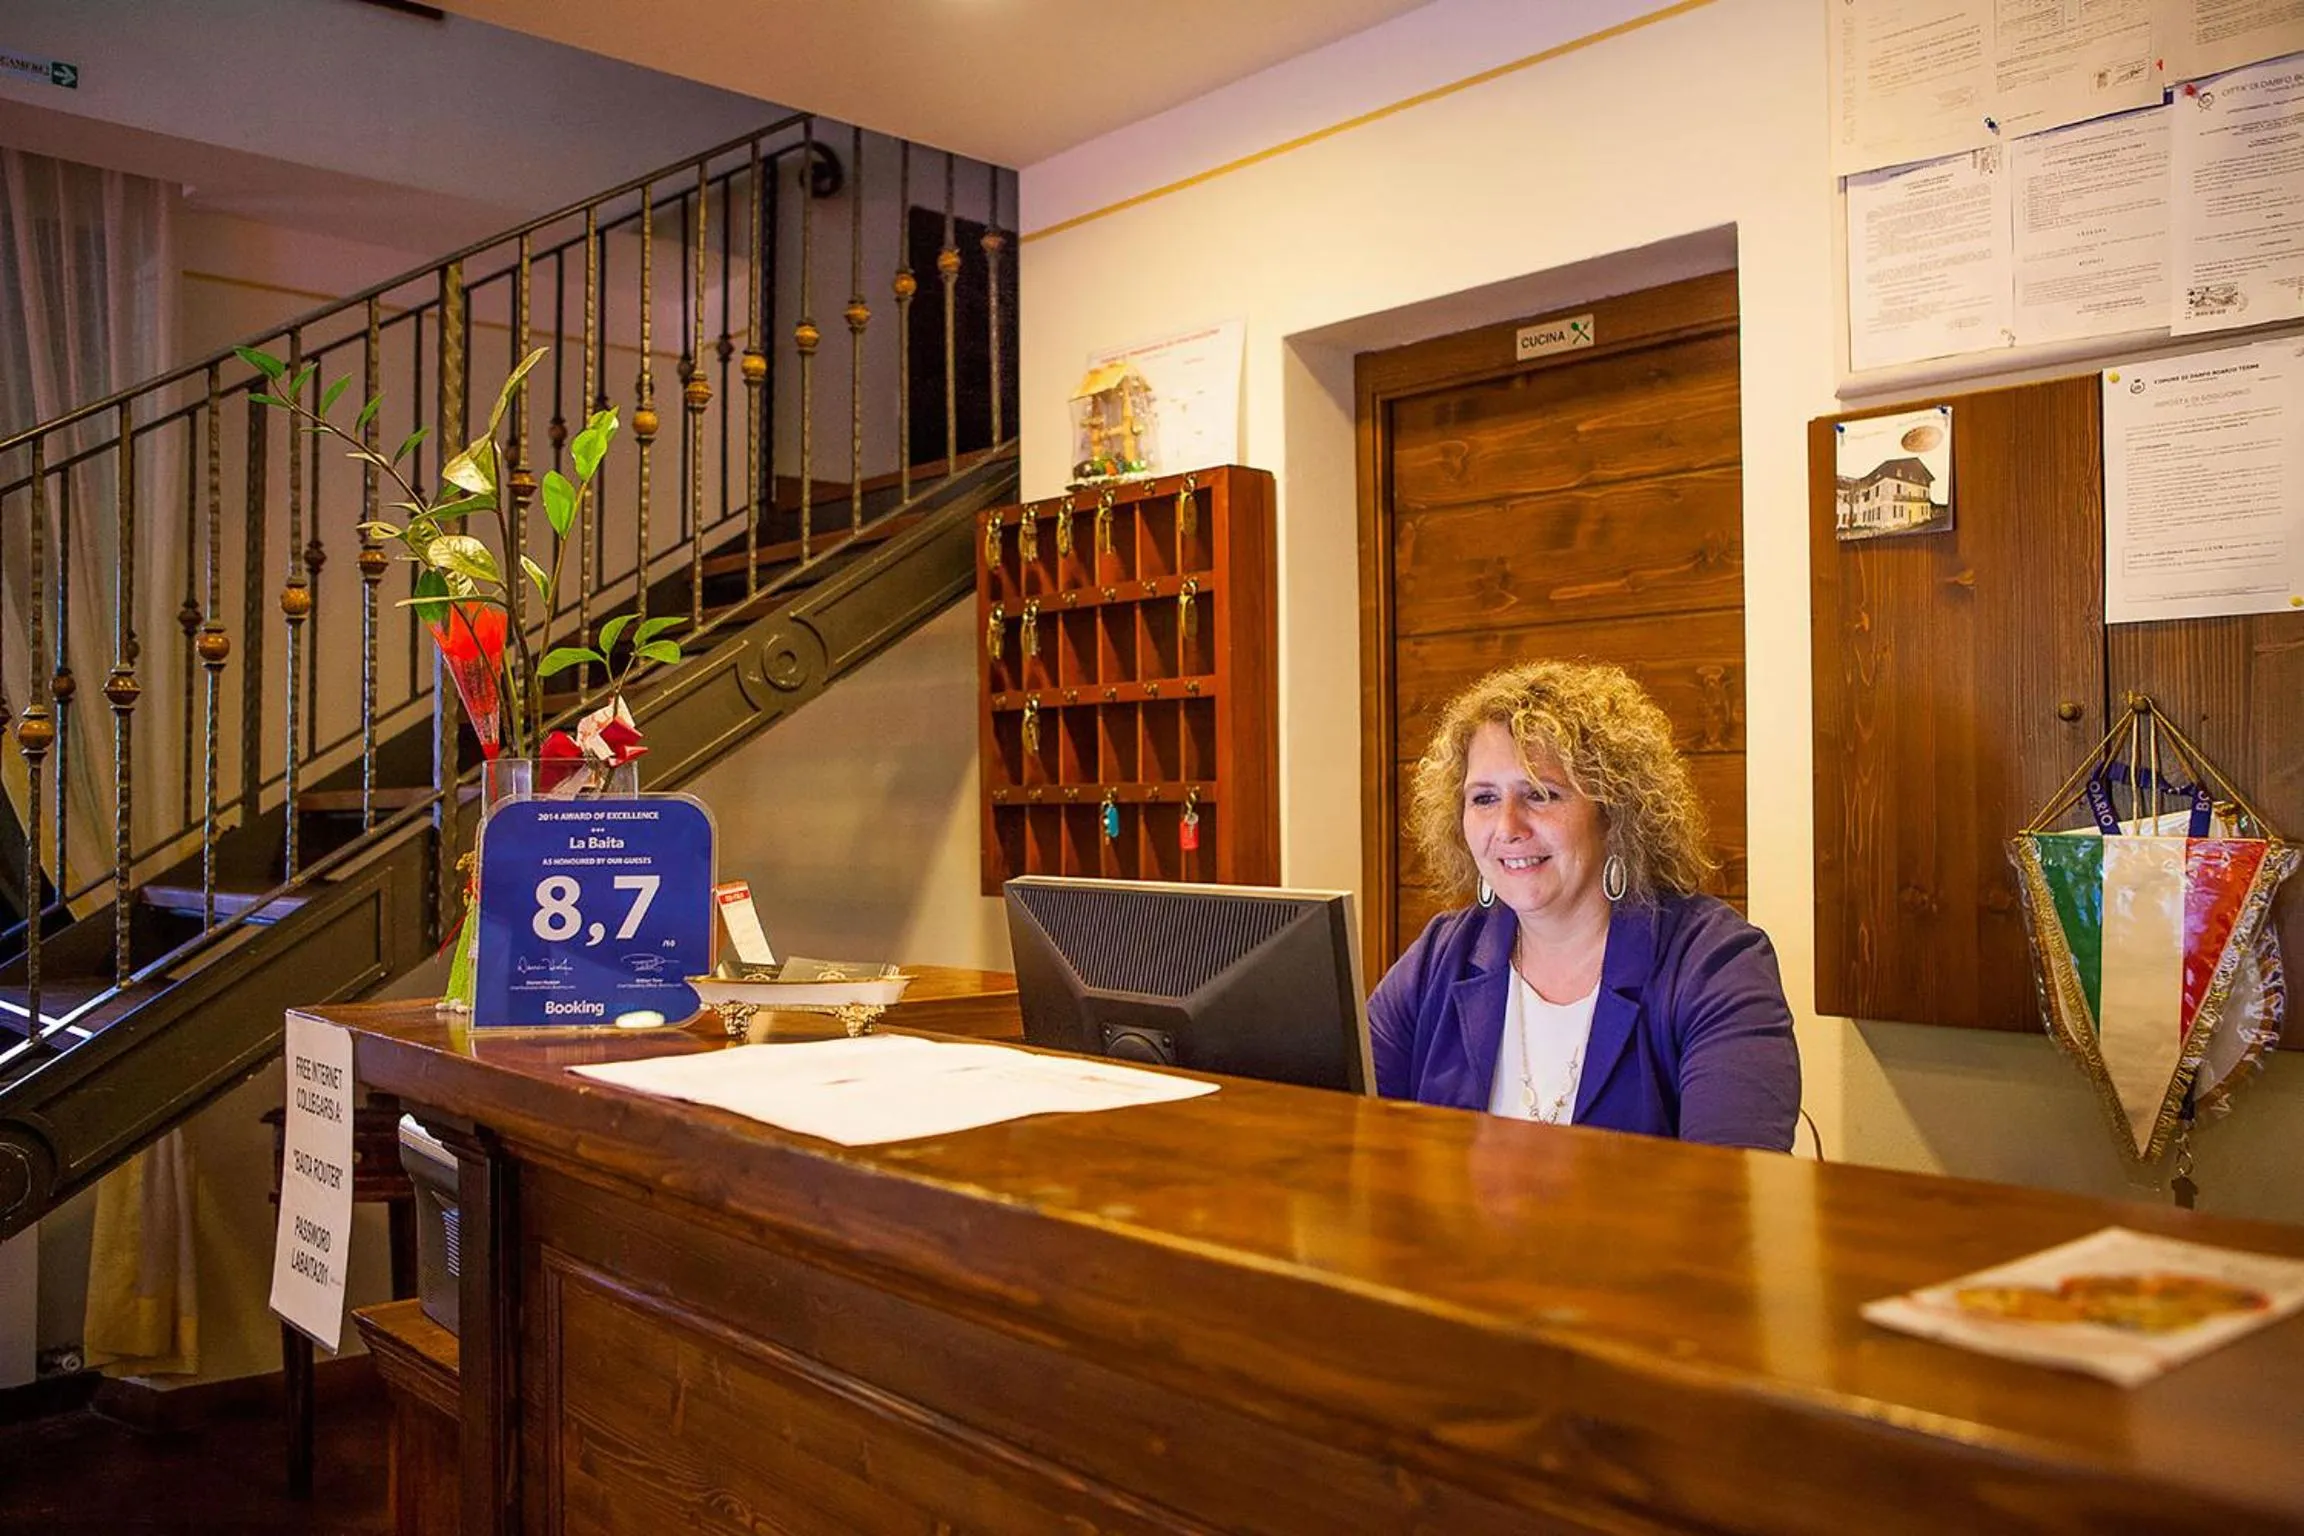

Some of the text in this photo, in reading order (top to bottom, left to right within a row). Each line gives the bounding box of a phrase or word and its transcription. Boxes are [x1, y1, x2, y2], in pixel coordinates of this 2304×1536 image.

[1521, 331, 1566, 348] CUCINA
[538, 810, 659, 821] 2014 AWARD OF EXCELLENCE
[569, 836, 625, 849] La Baita
[542, 856, 653, 866] AS HONOURED BY OUR GUESTS
[532, 875, 661, 947] 8,7
[545, 1000, 605, 1017] Booking
[296, 1056, 343, 1090] FREE INTERNET
[296, 1086, 334, 1121] COLLEGARSI
[295, 1215, 331, 1253] PASSWORD
